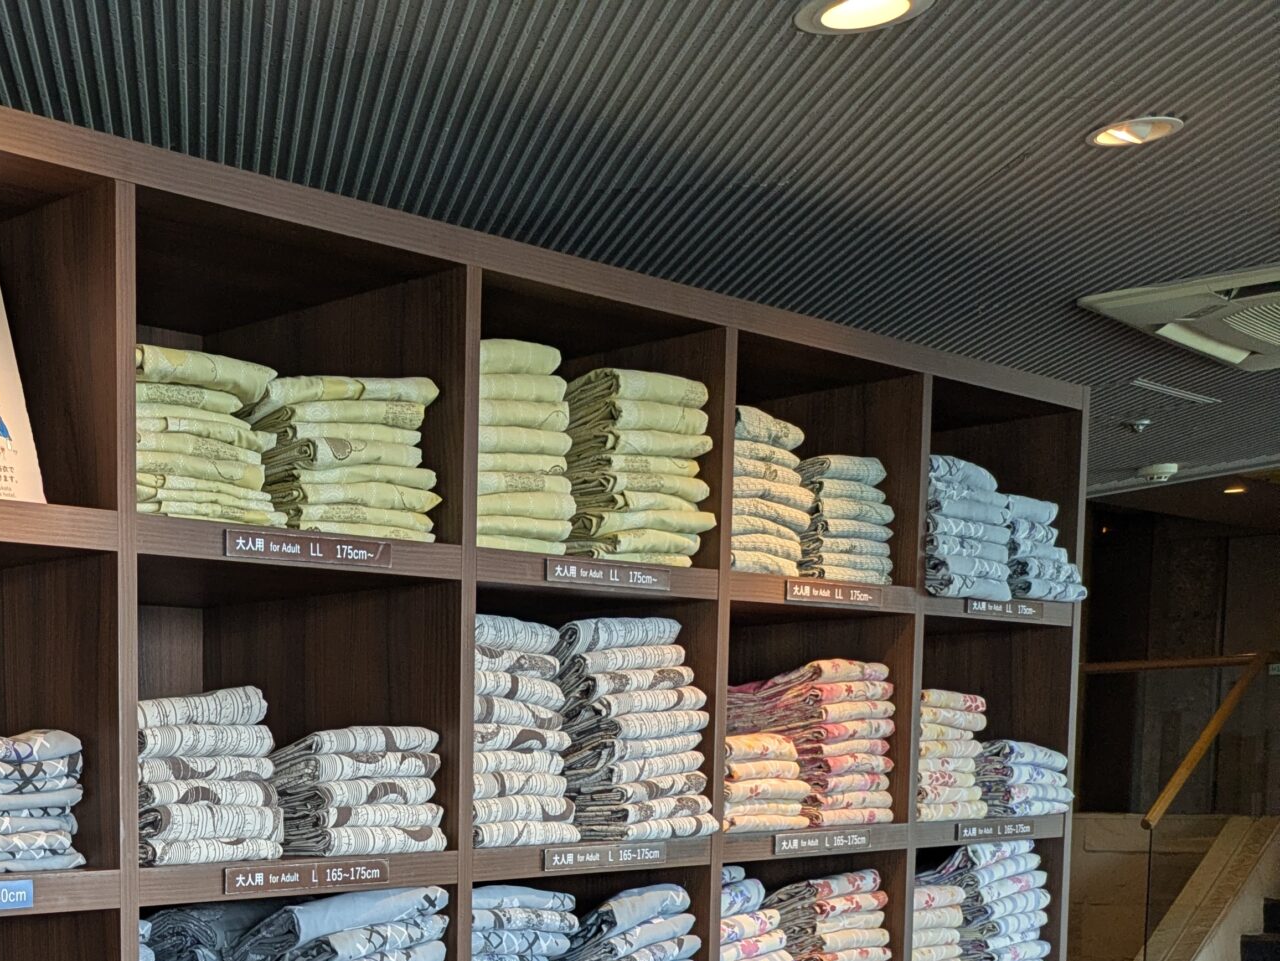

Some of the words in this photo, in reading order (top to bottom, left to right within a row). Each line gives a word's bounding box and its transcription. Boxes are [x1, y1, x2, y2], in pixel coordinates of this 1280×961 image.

[235, 536, 265, 552] 大人用
[270, 541, 280, 553] for
[281, 543, 301, 554] Adult
[310, 542, 323, 557] LL
[555, 564, 577, 578] 大人用
[580, 568, 588, 577] for
[589, 568, 603, 579] Adult
[609, 568, 620, 582] LL
[792, 585, 810, 597] 大人用
[835, 588, 843, 600] LL
[1005, 603, 1013, 614] LL
[997, 825, 1002, 835] L
[781, 839, 799, 850] 大人用
[825, 836, 830, 847] L
[552, 853, 574, 866] 大人用
[577, 853, 585, 862] for
[585, 852, 600, 862] Adult
[608, 850, 614, 862] L
[235, 872, 264, 888] 大人用
[269, 874, 279, 883] for
[281, 872, 299, 882] Adult
[311, 870, 318, 883] L
